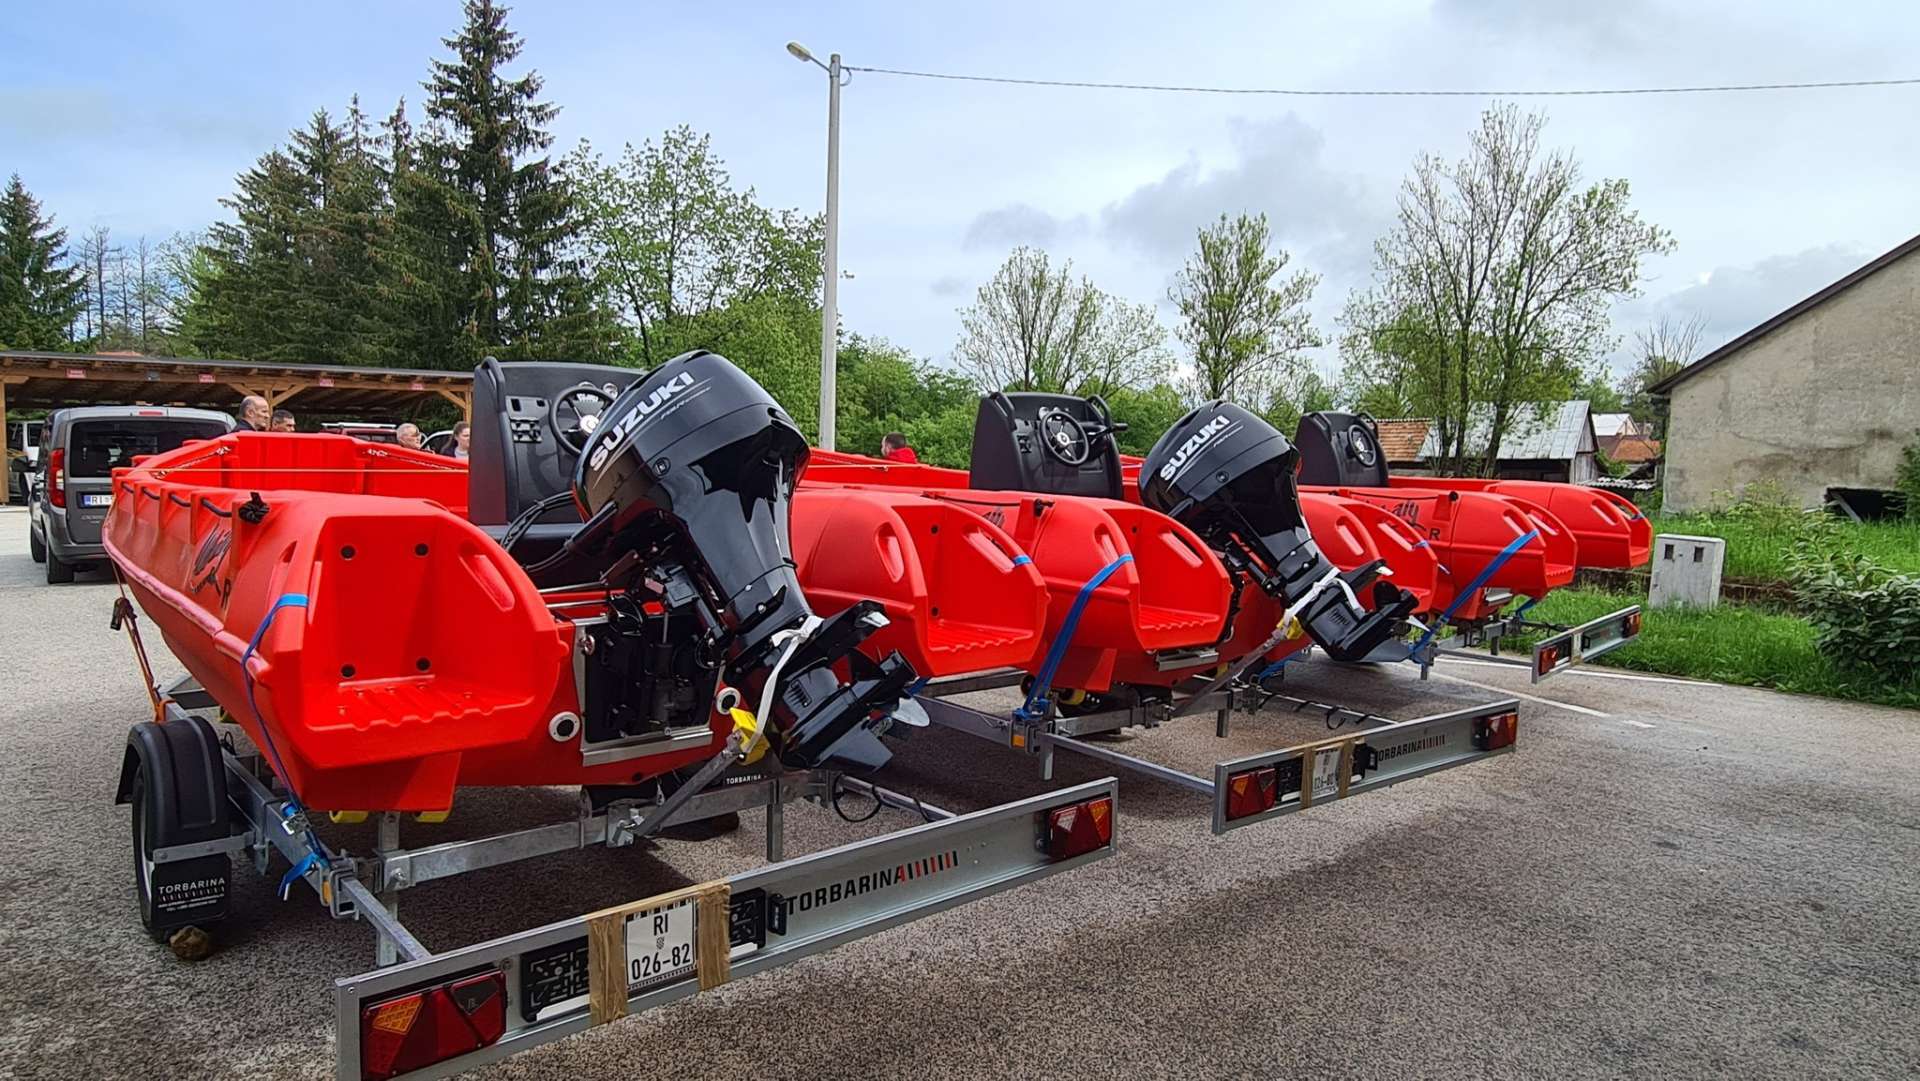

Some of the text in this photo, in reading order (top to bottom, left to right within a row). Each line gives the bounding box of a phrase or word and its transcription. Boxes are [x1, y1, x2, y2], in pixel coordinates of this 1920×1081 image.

[590, 371, 695, 472] SUZUKI
[1160, 415, 1231, 481] SUZUKI
[1429, 527, 1441, 541] R
[158, 878, 225, 894] TORBARINA
[786, 865, 906, 916] TORBARINA
[653, 913, 669, 936] RI
[631, 943, 691, 980] 026-82
